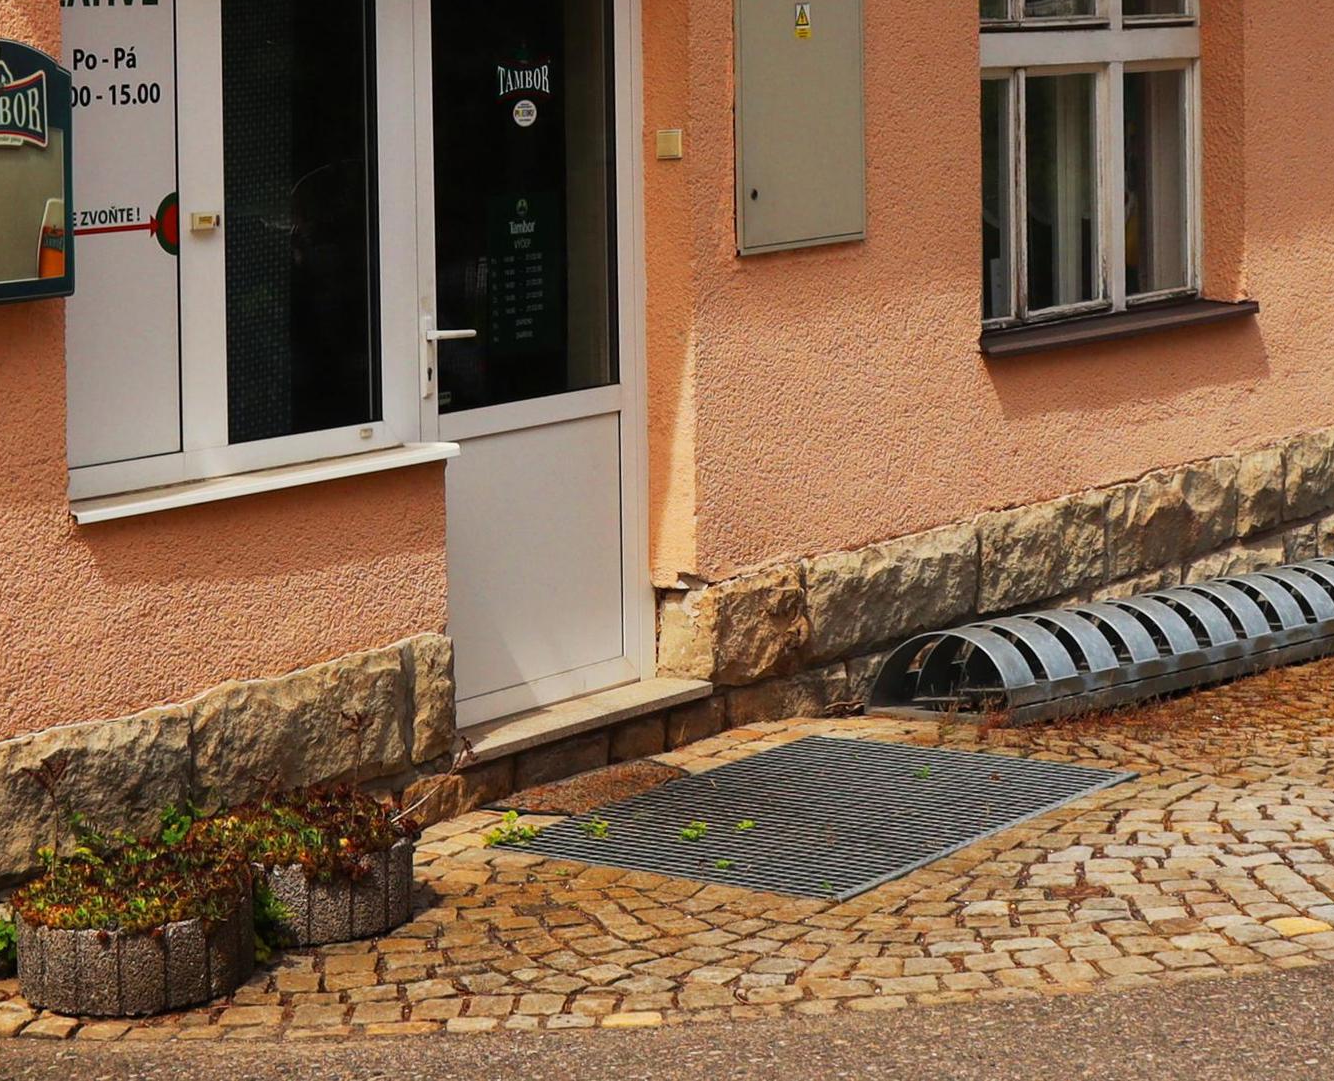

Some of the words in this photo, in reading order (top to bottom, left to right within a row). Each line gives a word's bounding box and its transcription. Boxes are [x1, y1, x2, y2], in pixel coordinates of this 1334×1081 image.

[73, 48, 97, 70] Po
[114, 46, 137, 69] Pá
[497, 64, 550, 96] TAMBOR
[108, 82, 161, 105] 15.00
[508, 219, 536, 234] Tambor
